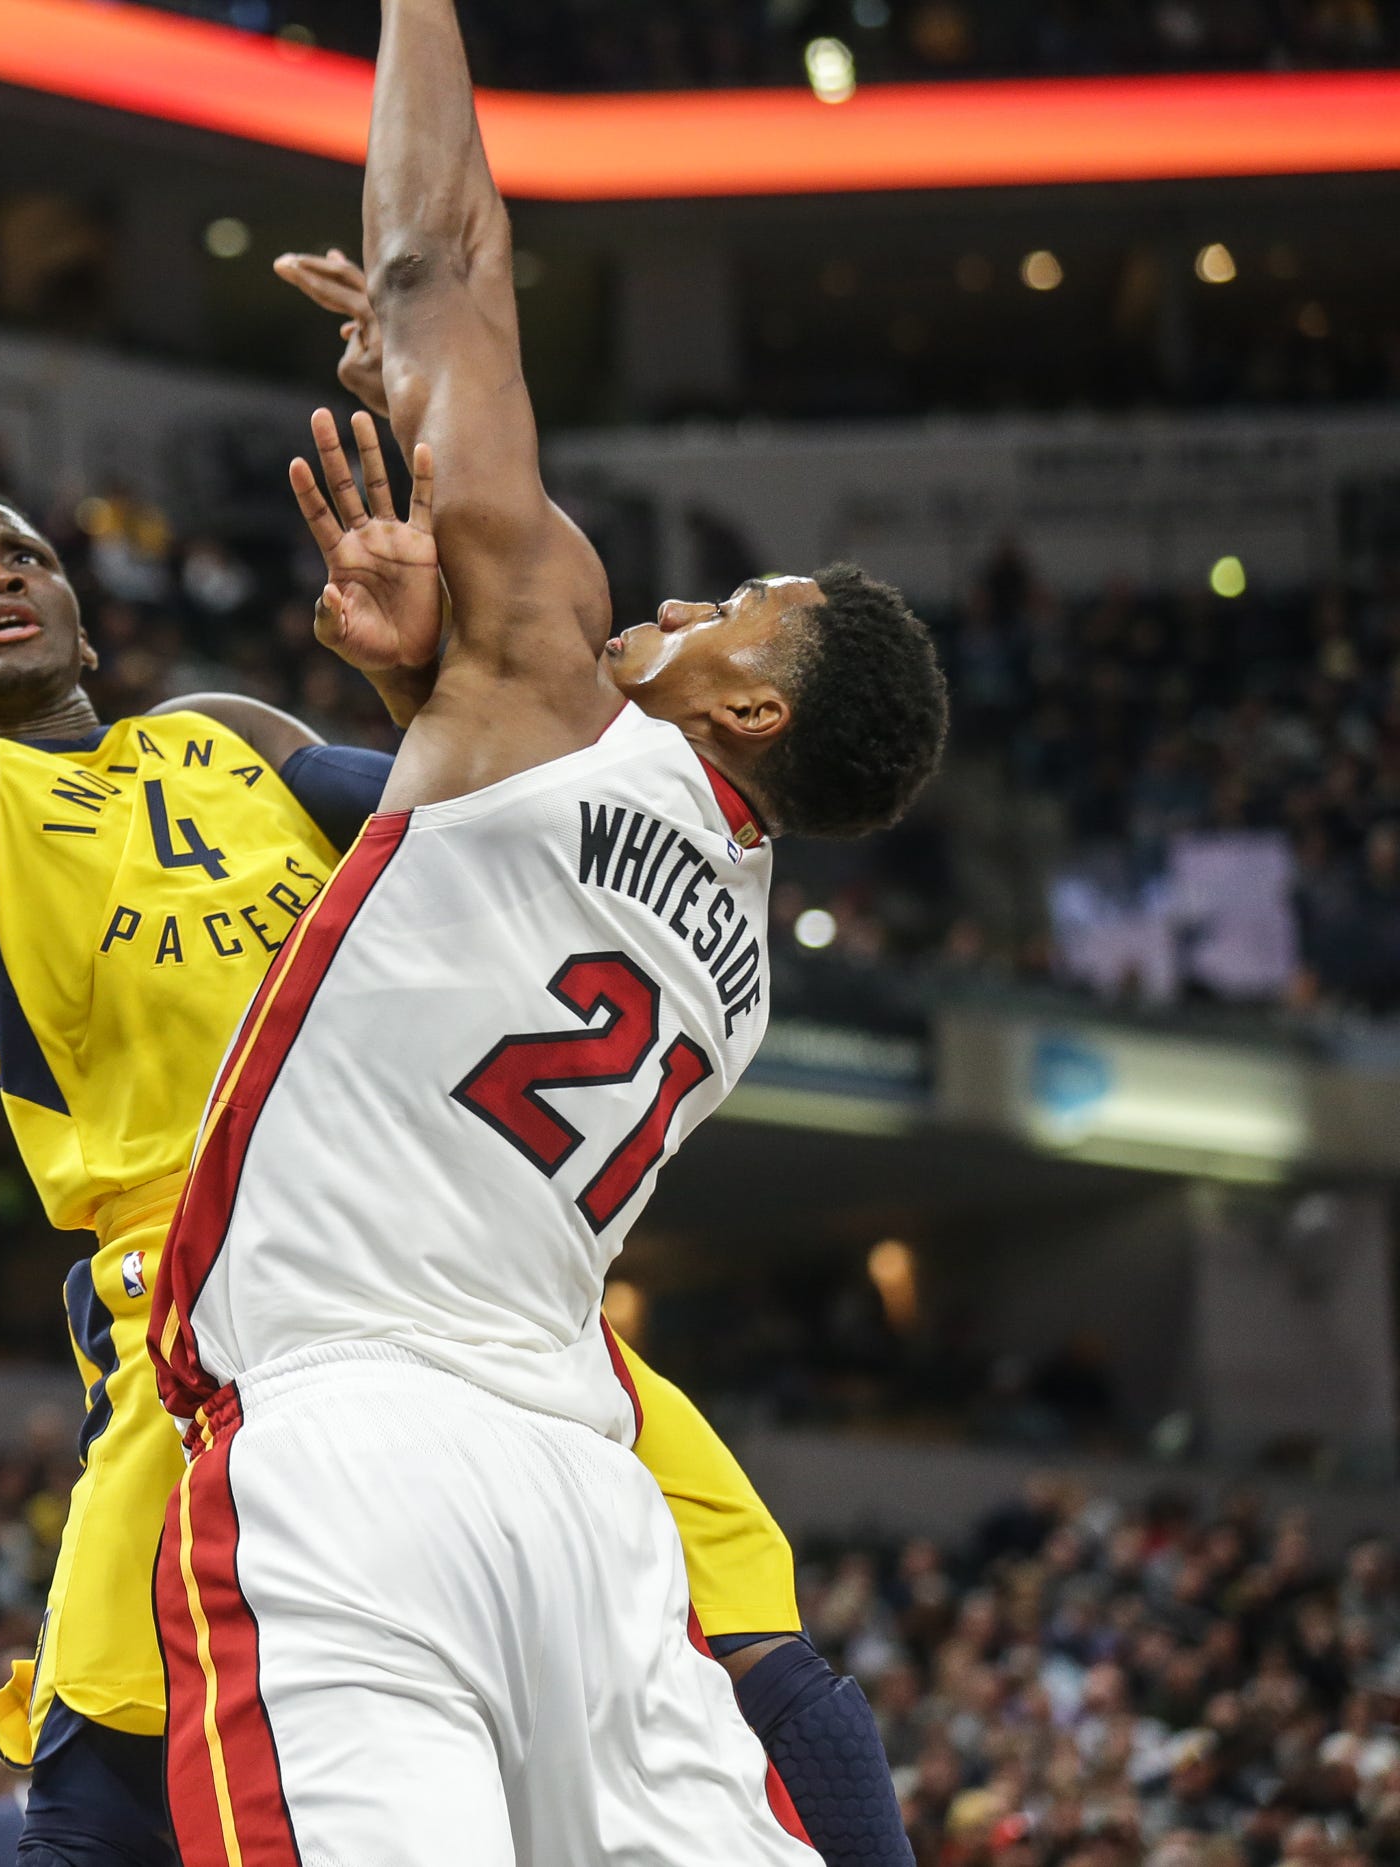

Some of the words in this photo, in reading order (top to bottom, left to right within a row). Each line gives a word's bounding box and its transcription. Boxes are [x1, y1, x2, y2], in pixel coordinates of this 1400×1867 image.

[41, 729, 264, 836] INDIANA
[143, 778, 231, 882] 4
[99, 856, 327, 966] PACERS
[578, 800, 761, 1040] WHITESIDE
[449, 950, 714, 1236] 21
